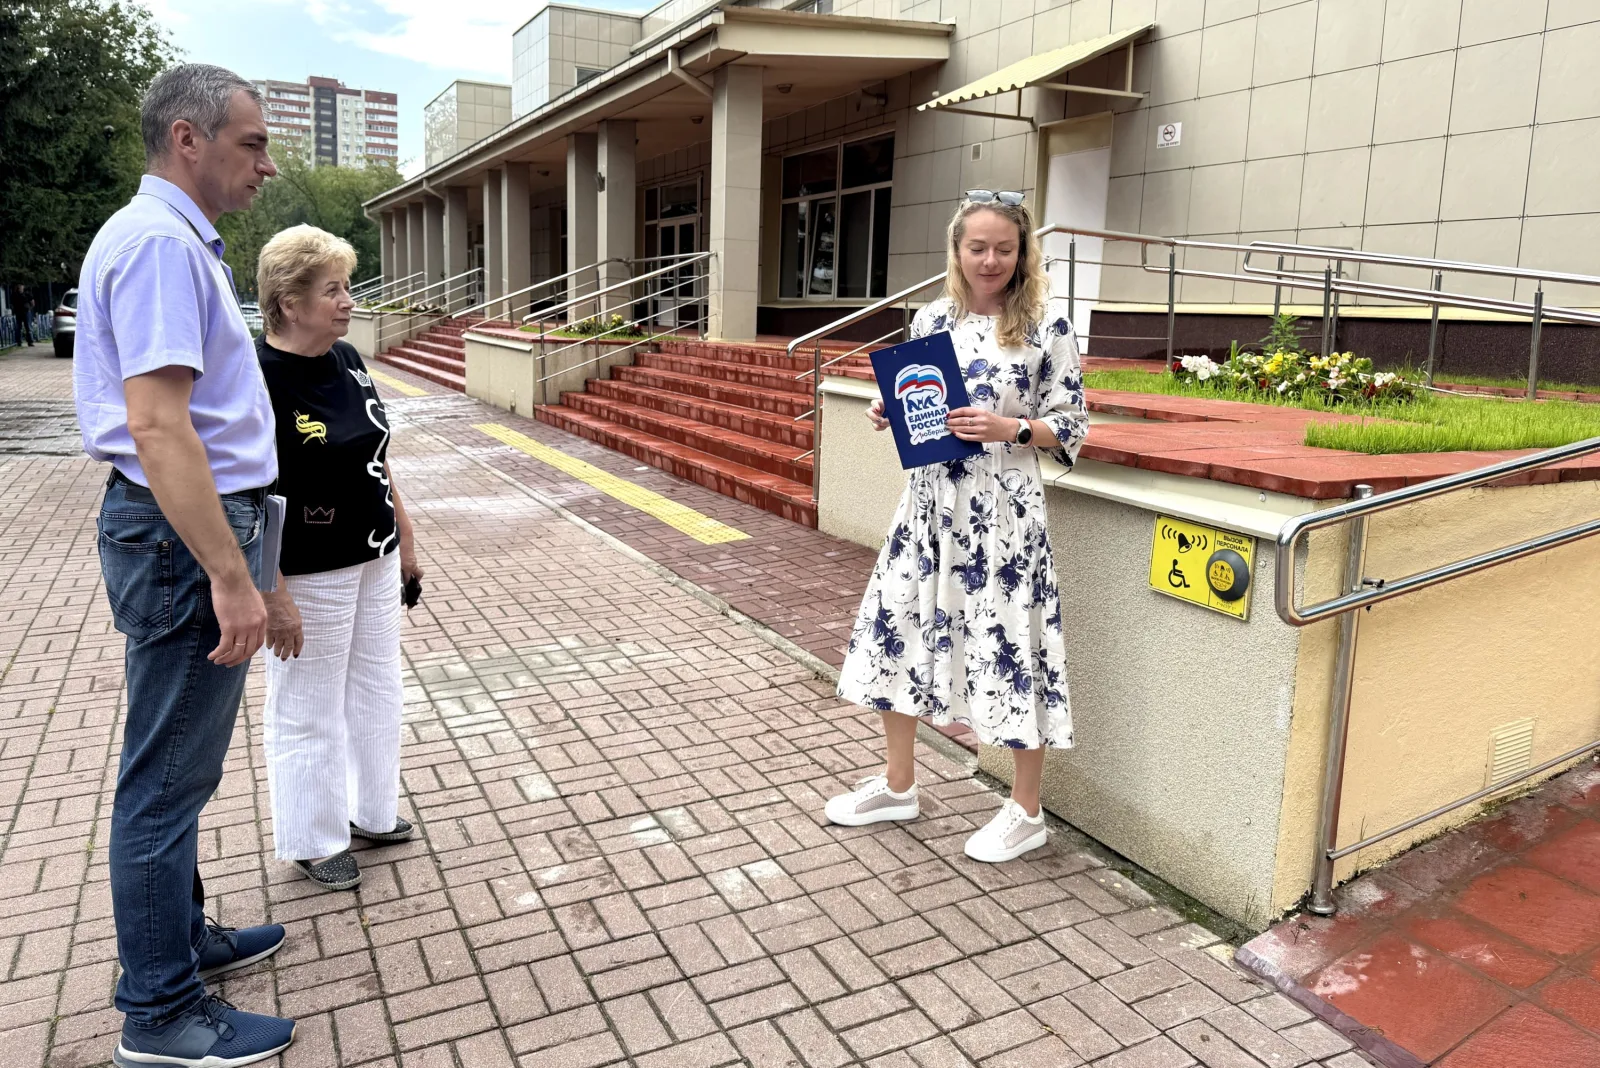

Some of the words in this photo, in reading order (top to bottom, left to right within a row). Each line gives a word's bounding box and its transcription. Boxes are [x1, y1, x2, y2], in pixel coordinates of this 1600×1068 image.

[908, 407, 947, 423] ЕДИНАЯ
[1216, 540, 1248, 553] ПЕРСОНАЛА
[1223, 535, 1243, 545] ВЫЗОВ
